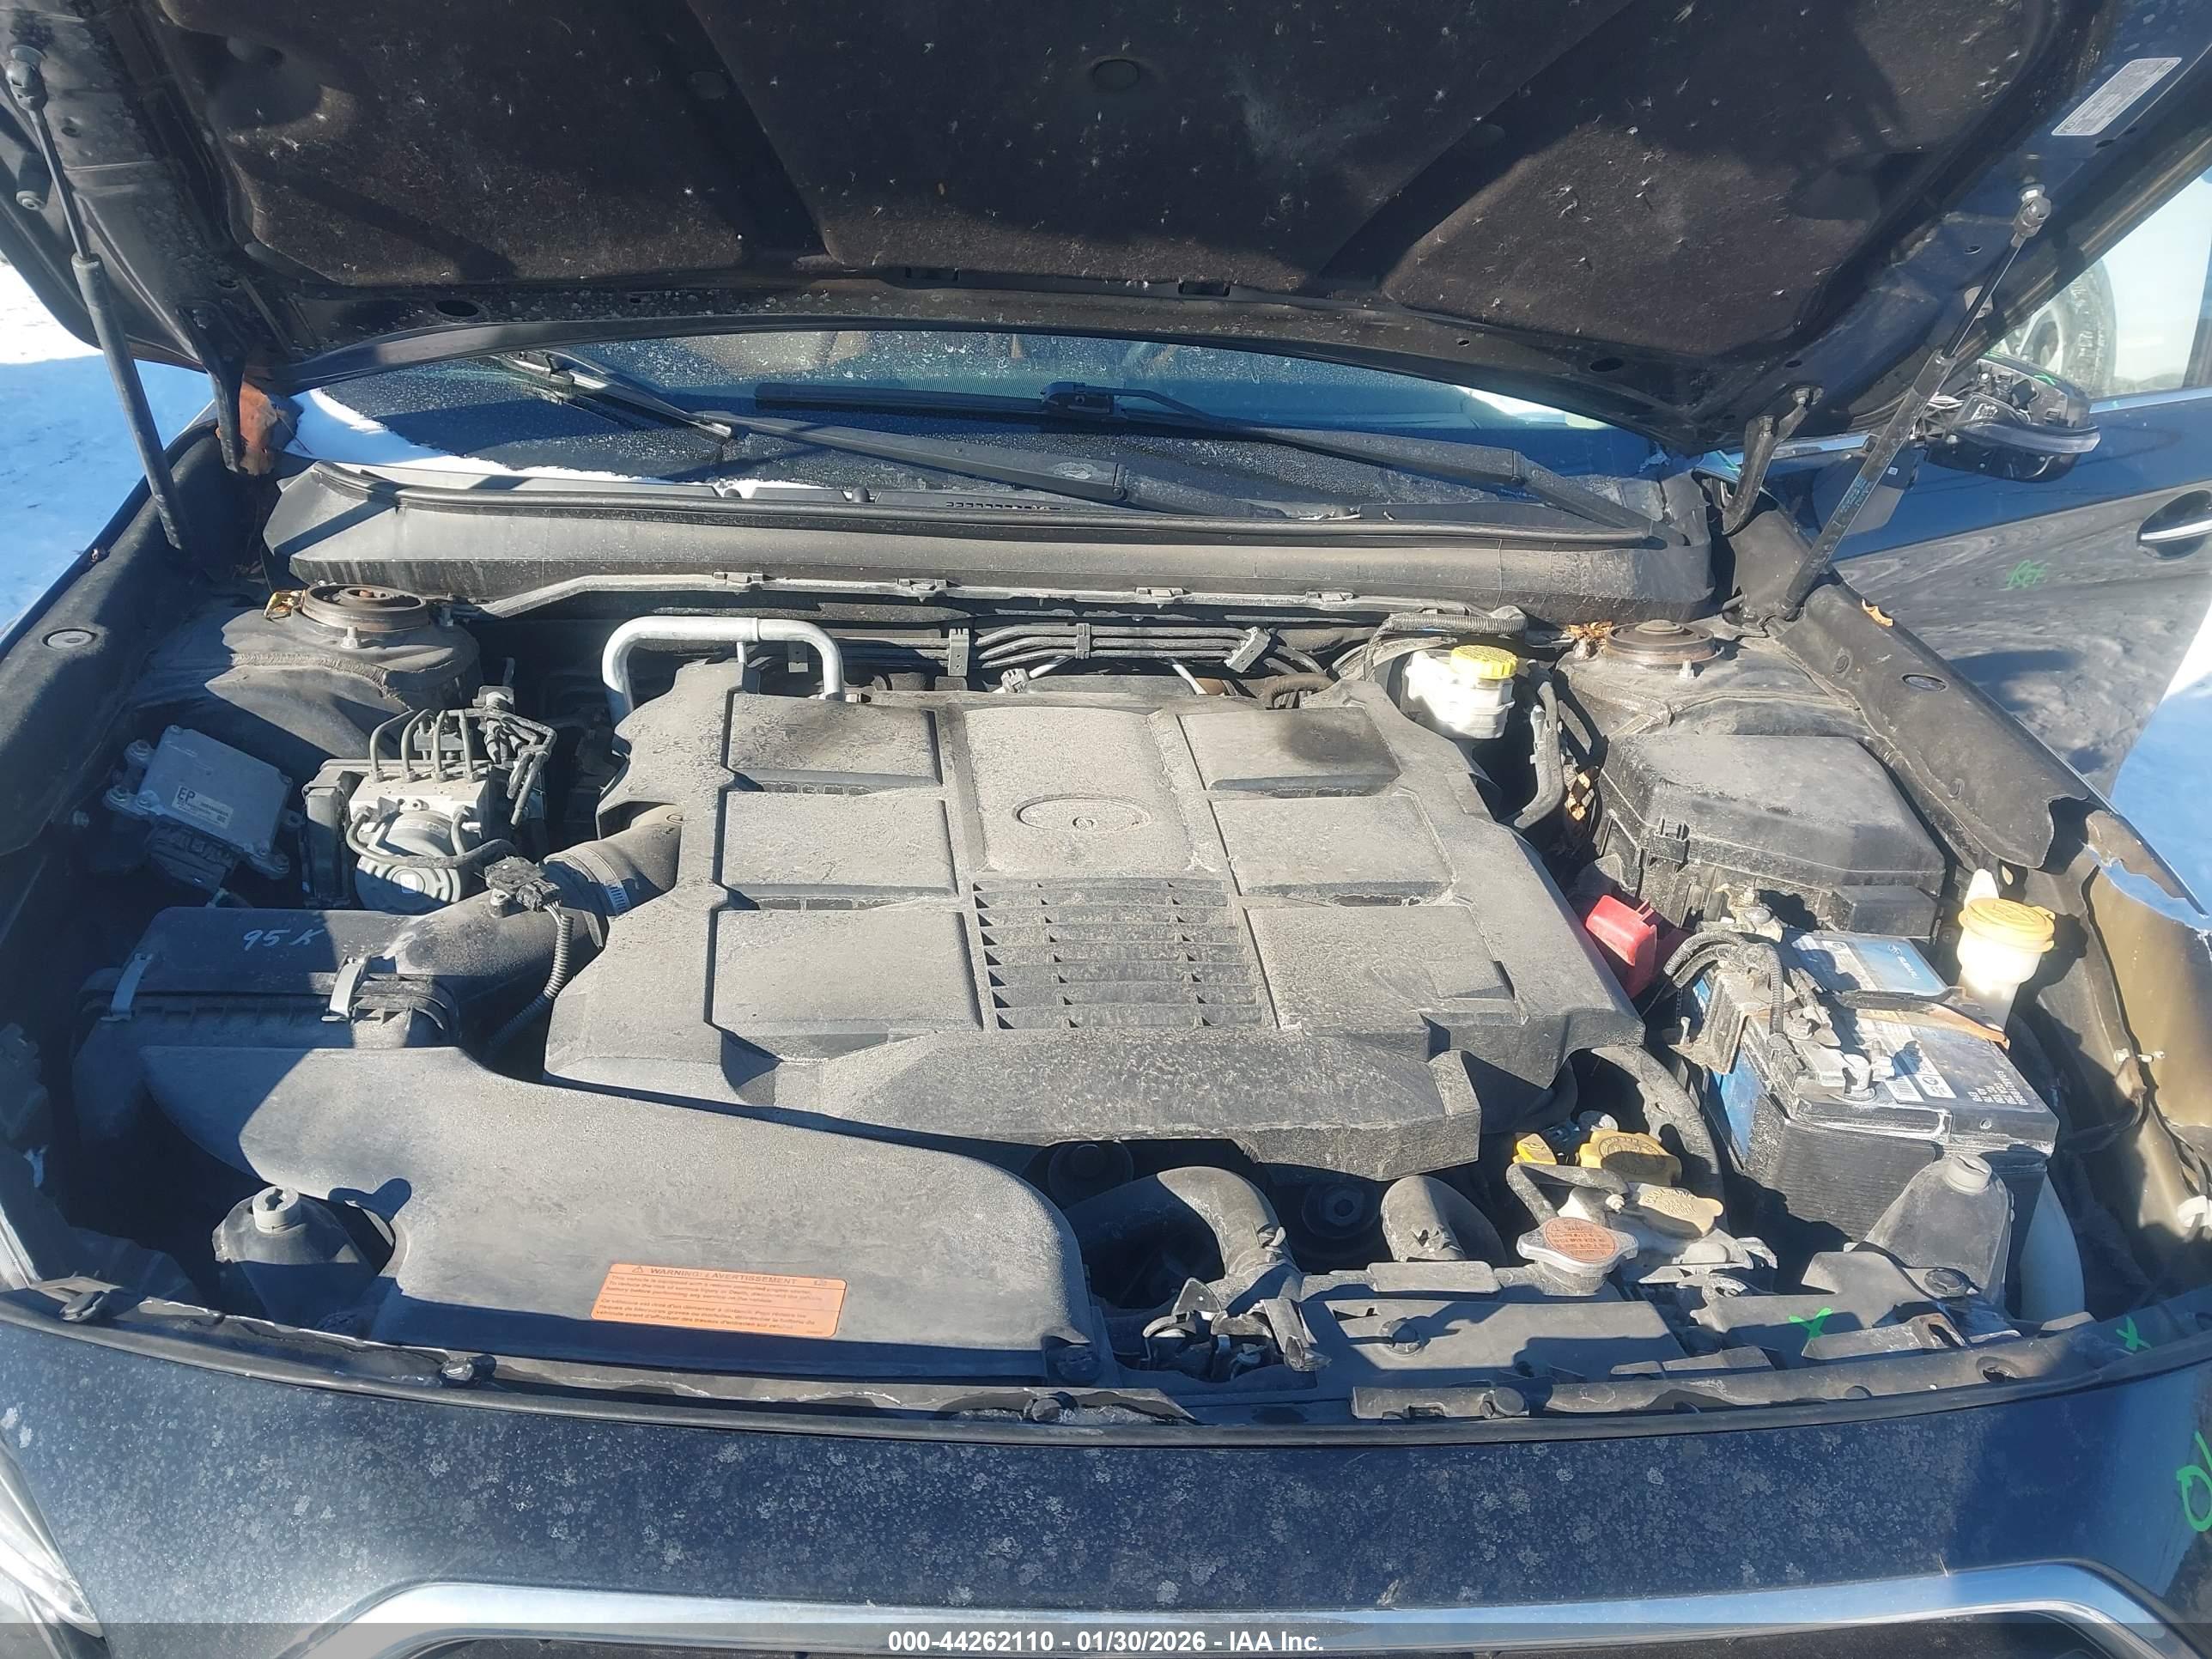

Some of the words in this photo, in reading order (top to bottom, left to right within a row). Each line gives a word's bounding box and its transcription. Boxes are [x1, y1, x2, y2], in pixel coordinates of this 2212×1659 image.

[177, 787, 196, 805] EP
[243, 929, 290, 951] 95
[711, 1273, 798, 1284] AVERTISSEMENT
